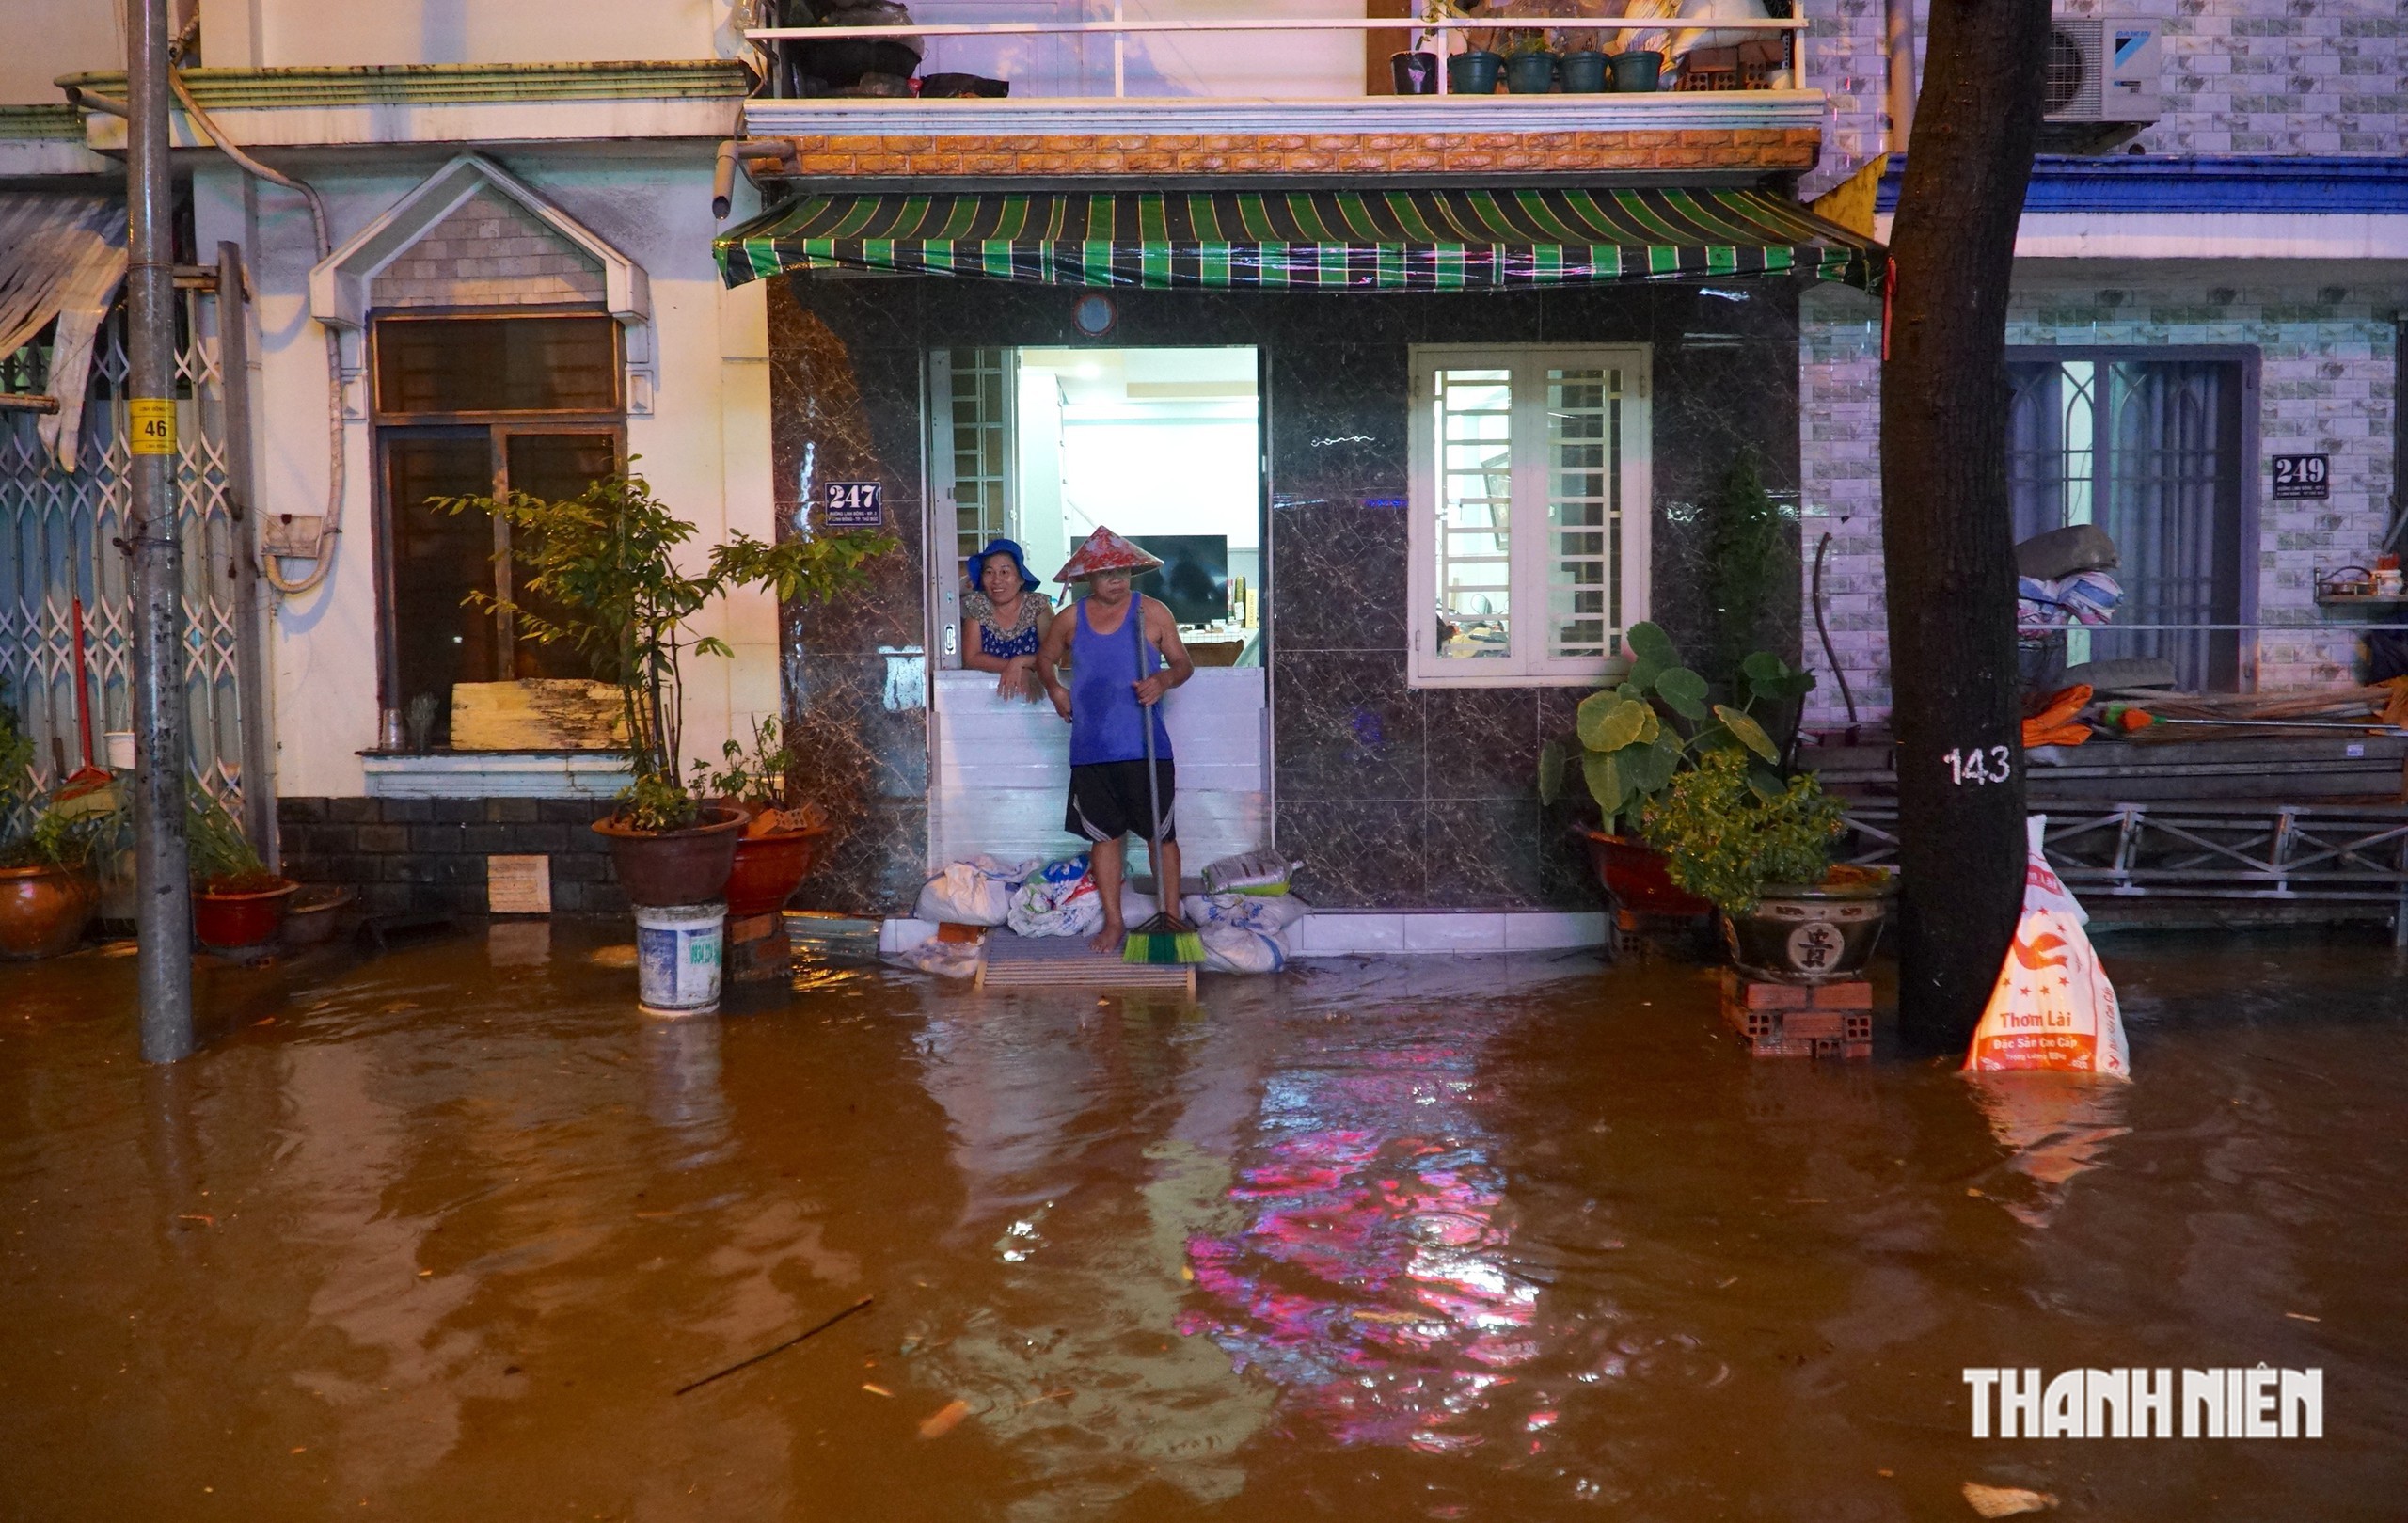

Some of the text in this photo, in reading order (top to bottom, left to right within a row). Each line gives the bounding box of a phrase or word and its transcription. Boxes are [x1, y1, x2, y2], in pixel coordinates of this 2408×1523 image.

[145, 420, 166, 437] 46
[2276, 458, 2325, 484] 249
[830, 485, 876, 508] 247
[1943, 745, 2011, 785] 143
[2000, 1010, 2072, 1028] Thơm Lài
